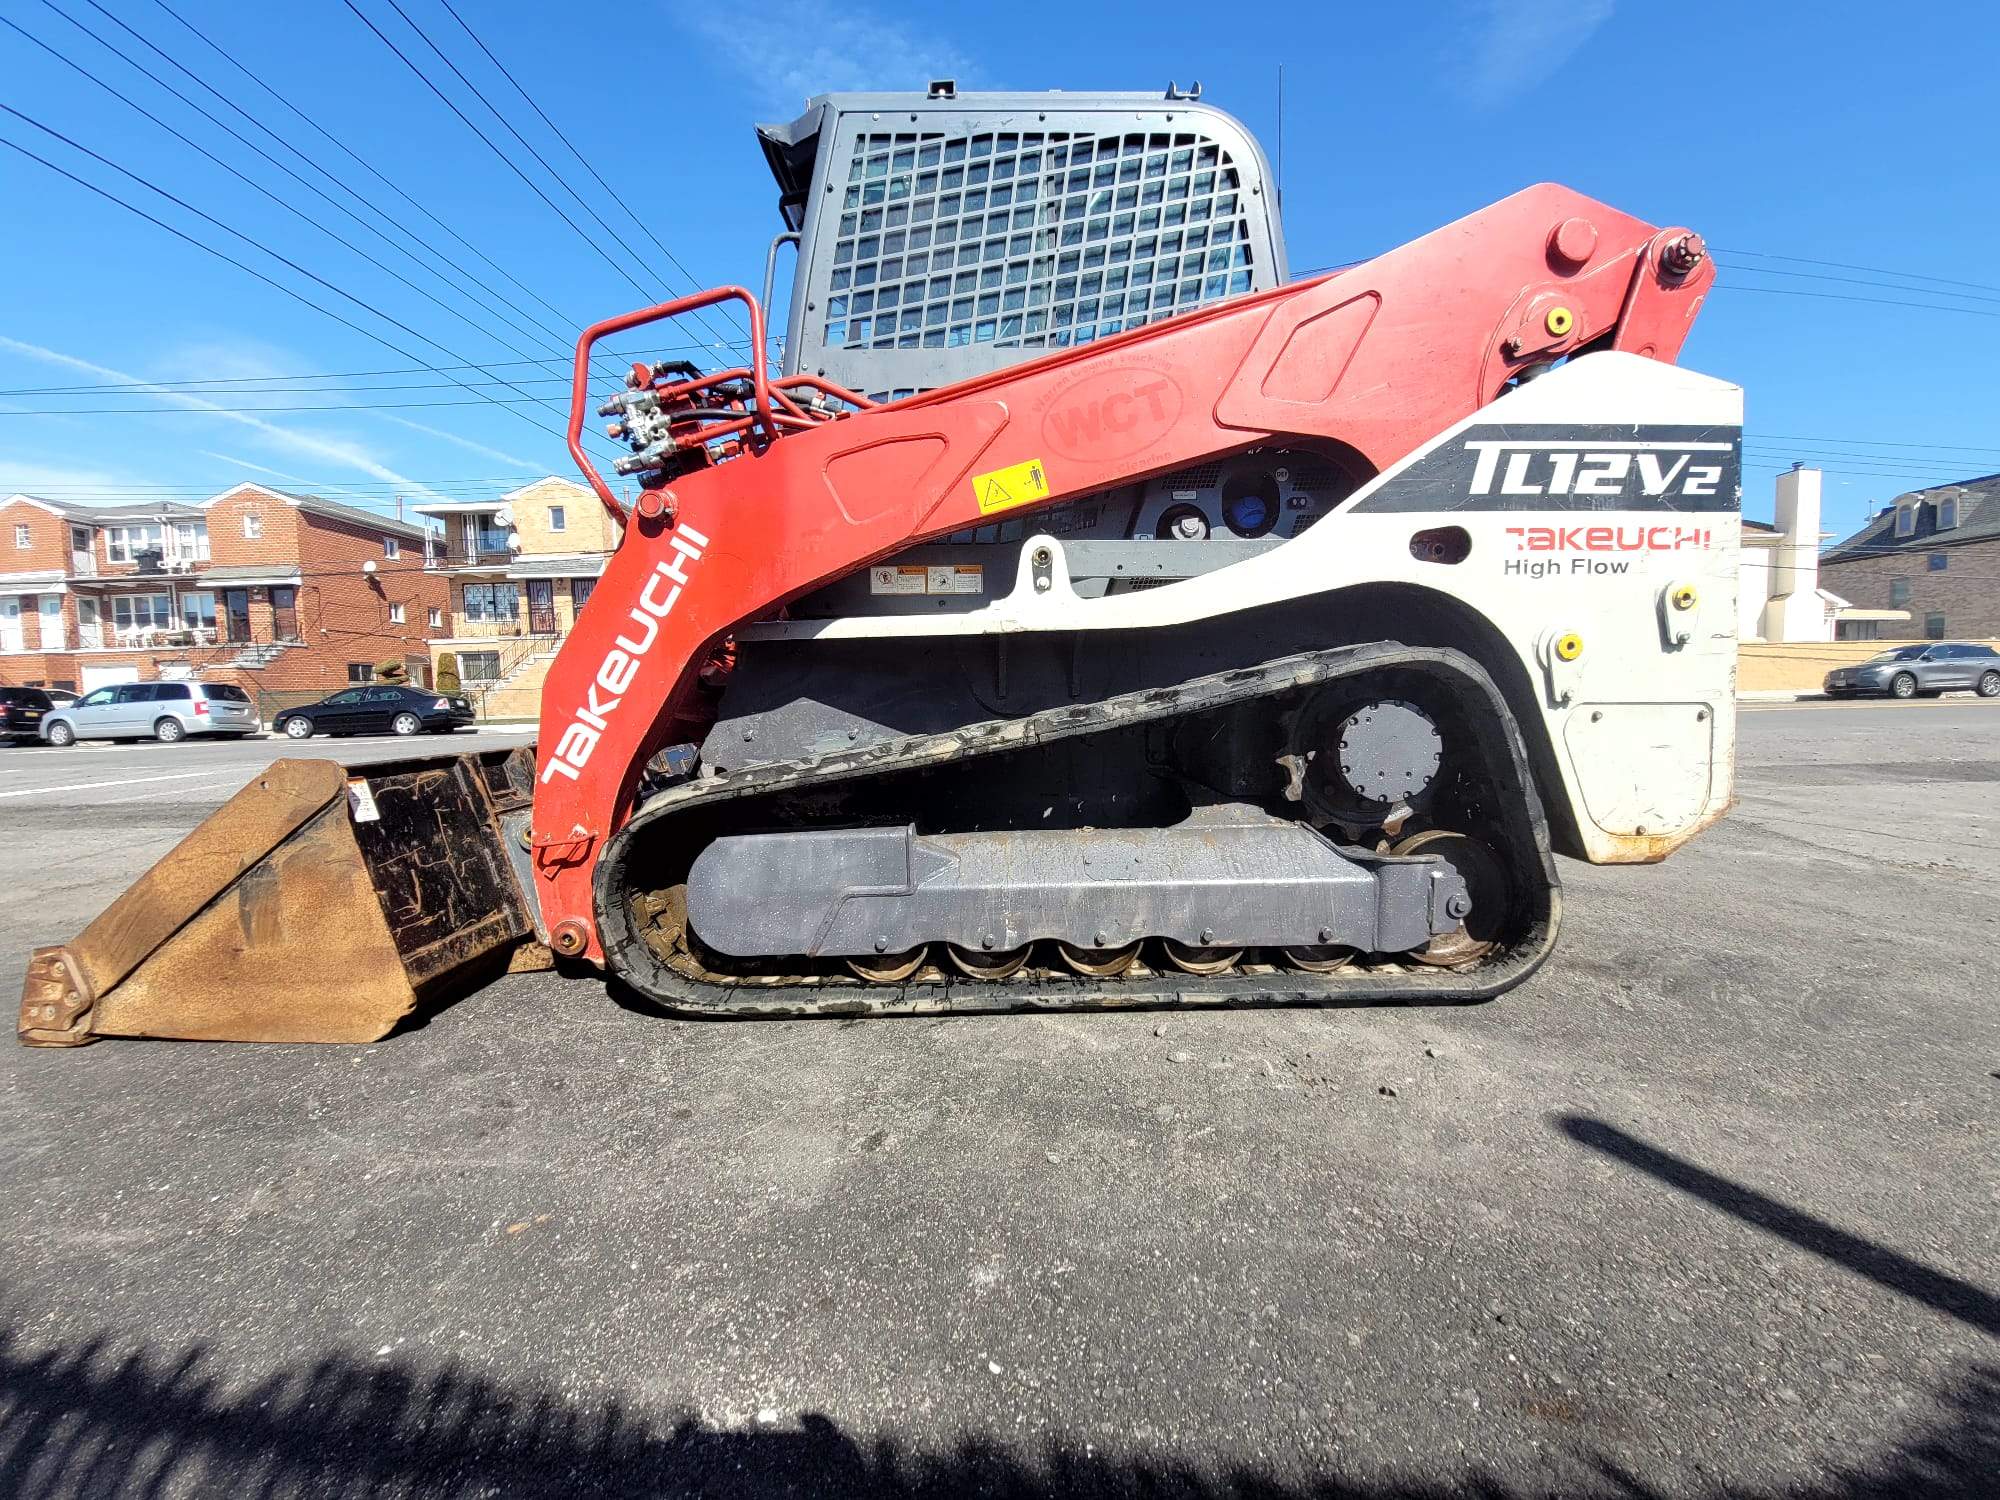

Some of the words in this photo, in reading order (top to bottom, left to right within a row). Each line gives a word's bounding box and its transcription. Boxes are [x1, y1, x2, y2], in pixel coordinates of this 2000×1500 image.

[1049, 379, 1169, 449] WCT
[1503, 558, 1561, 579] High
[1571, 558, 1630, 575] Flow
[540, 523, 710, 785] TAKEUCHI
